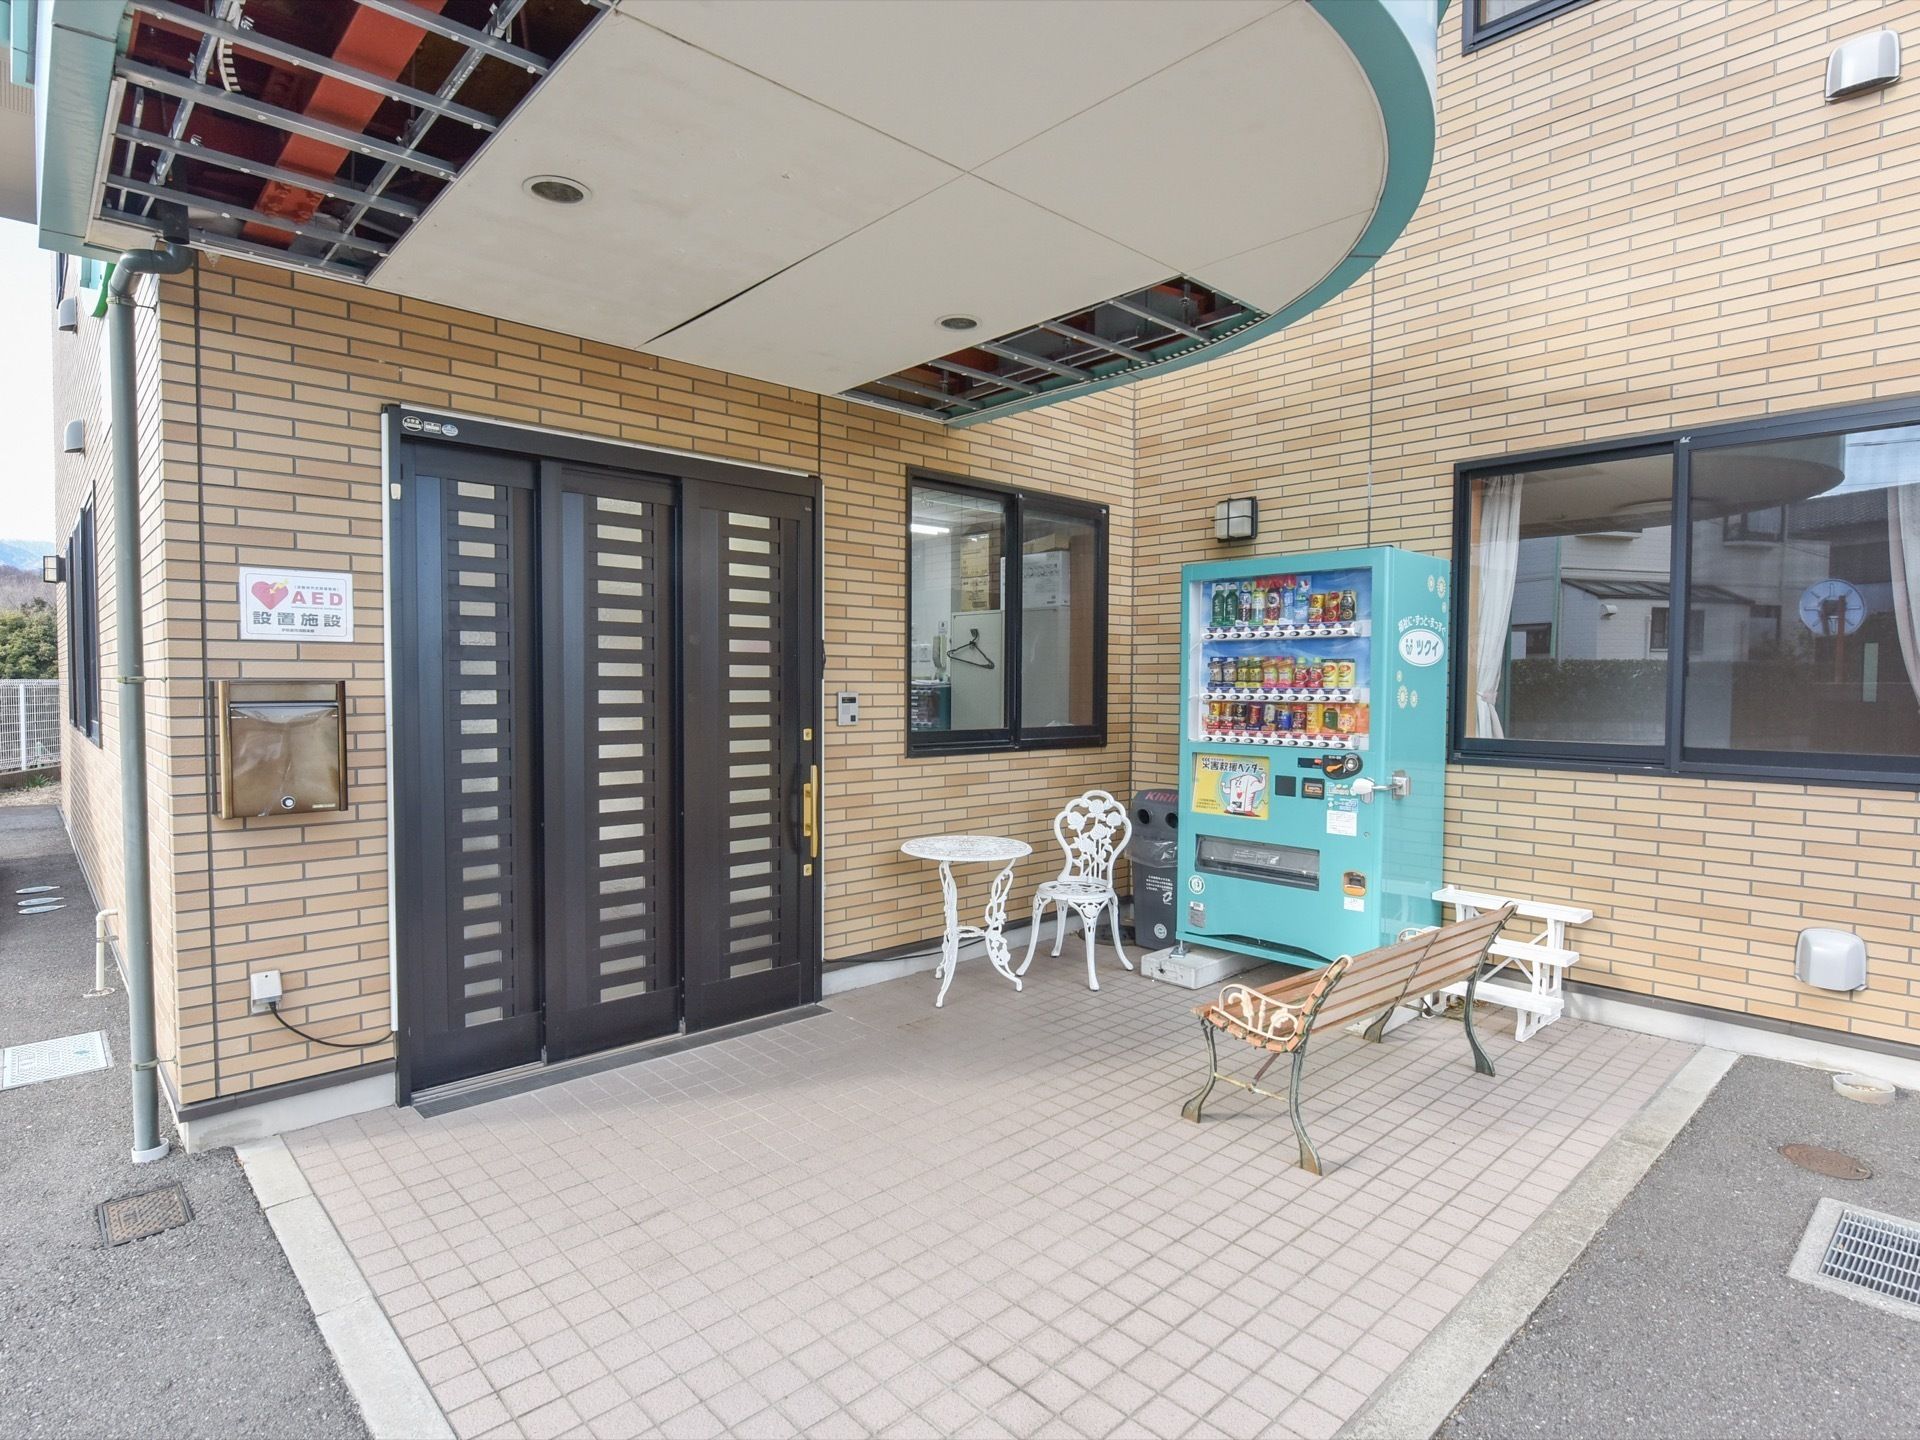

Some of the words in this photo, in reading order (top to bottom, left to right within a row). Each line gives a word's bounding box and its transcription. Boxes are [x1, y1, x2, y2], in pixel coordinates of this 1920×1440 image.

[291, 590, 343, 606] AED
[253, 611, 341, 628] 設置施設
[1416, 639, 1440, 657] ツクイ
